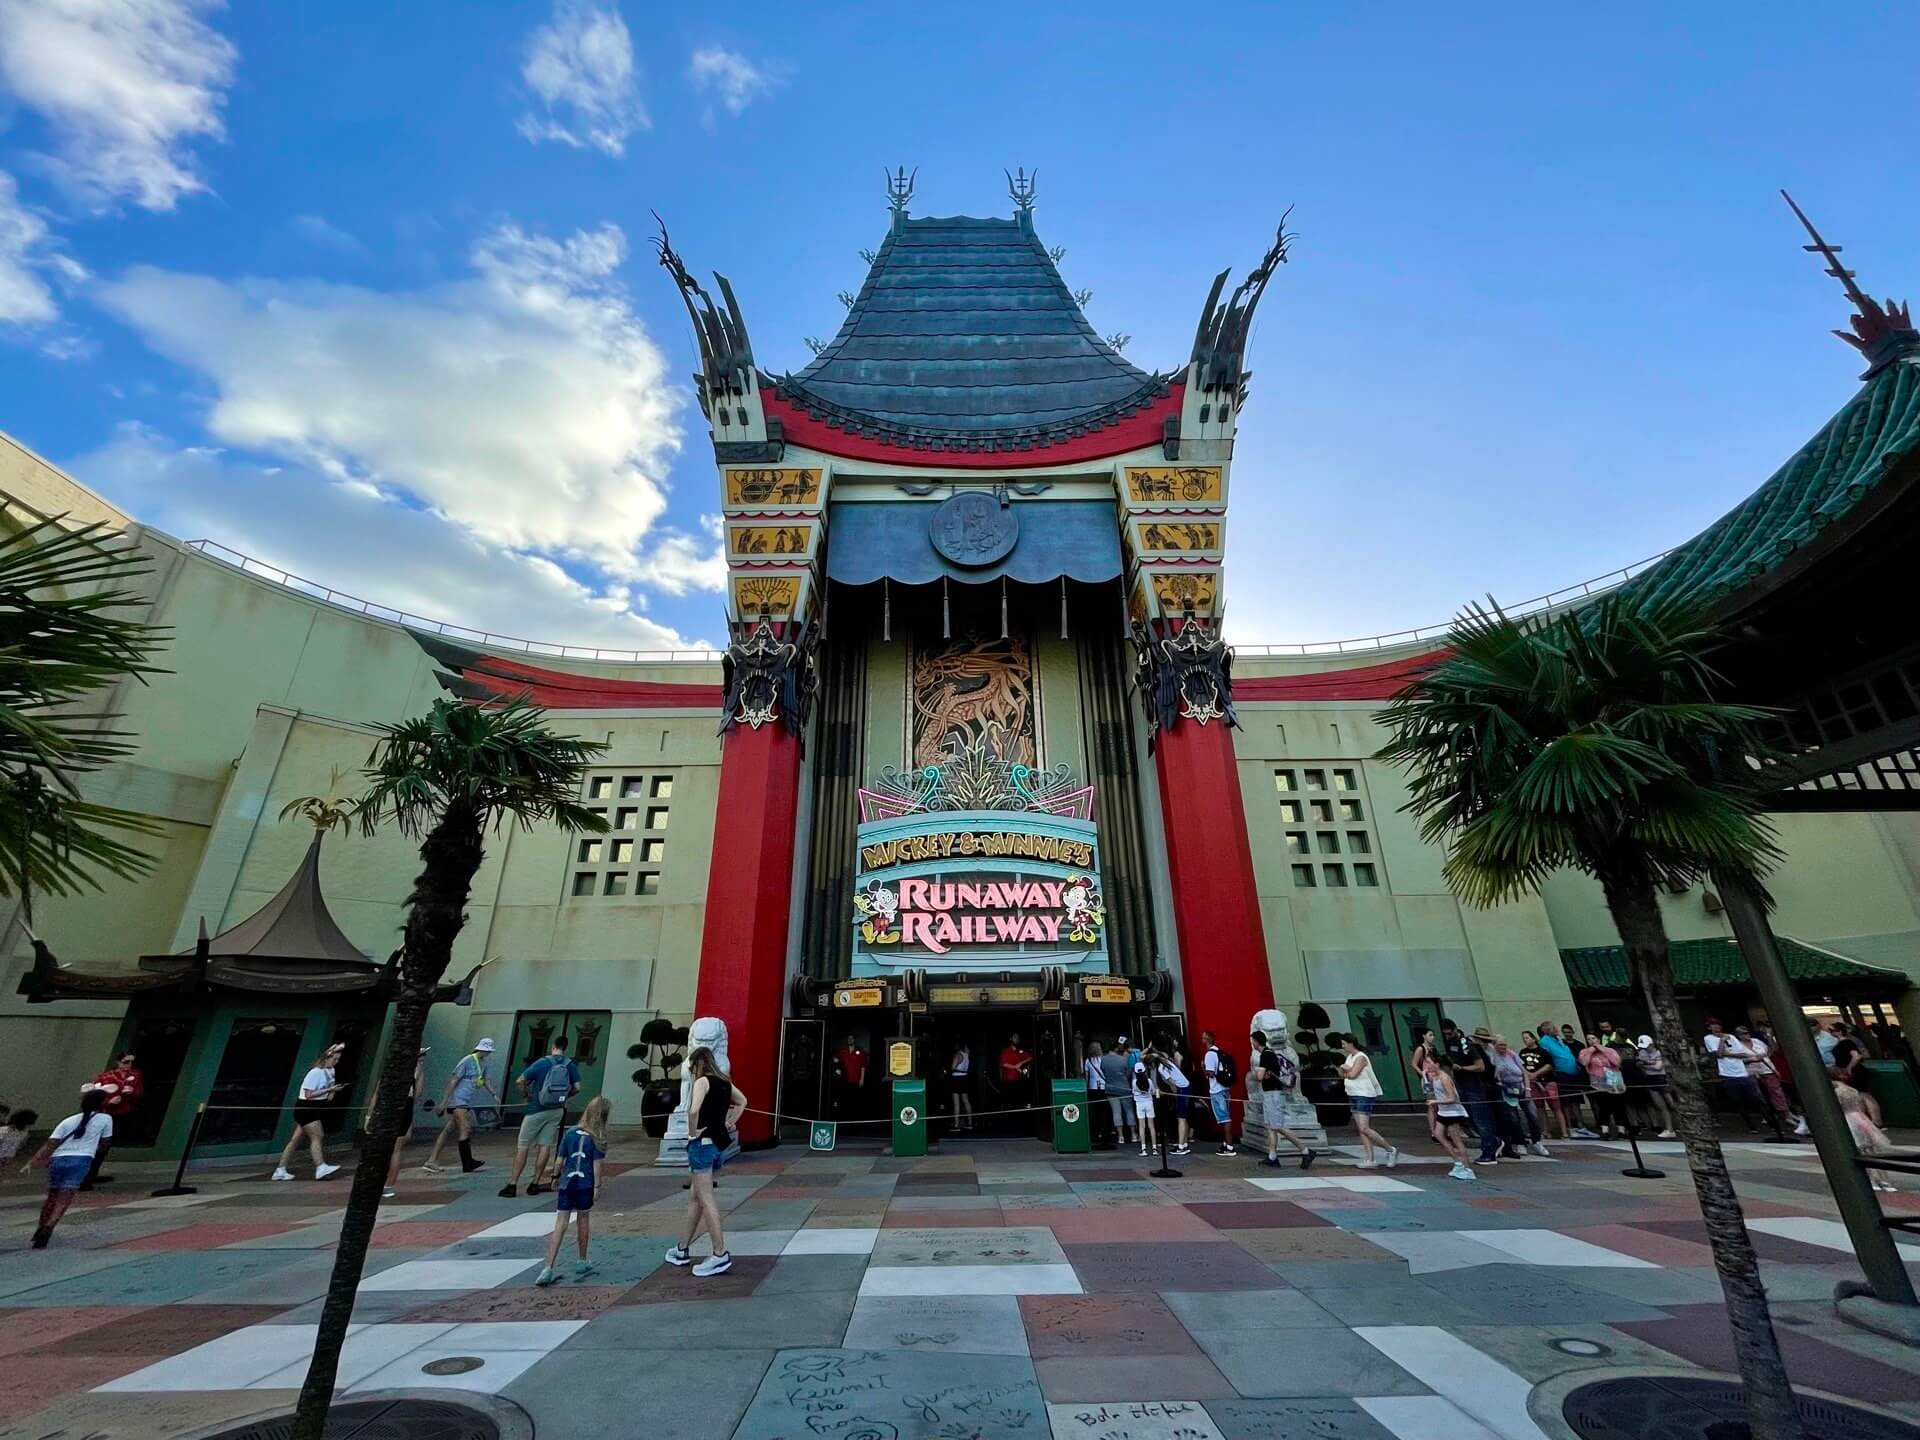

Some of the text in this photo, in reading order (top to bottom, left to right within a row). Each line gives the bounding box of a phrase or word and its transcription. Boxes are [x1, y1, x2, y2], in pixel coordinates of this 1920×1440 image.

[863, 832, 1091, 868] MICKEY & MINNIE'S
[899, 880, 1066, 910] RUNAWAY
[902, 913, 1063, 953] RAILWAY
